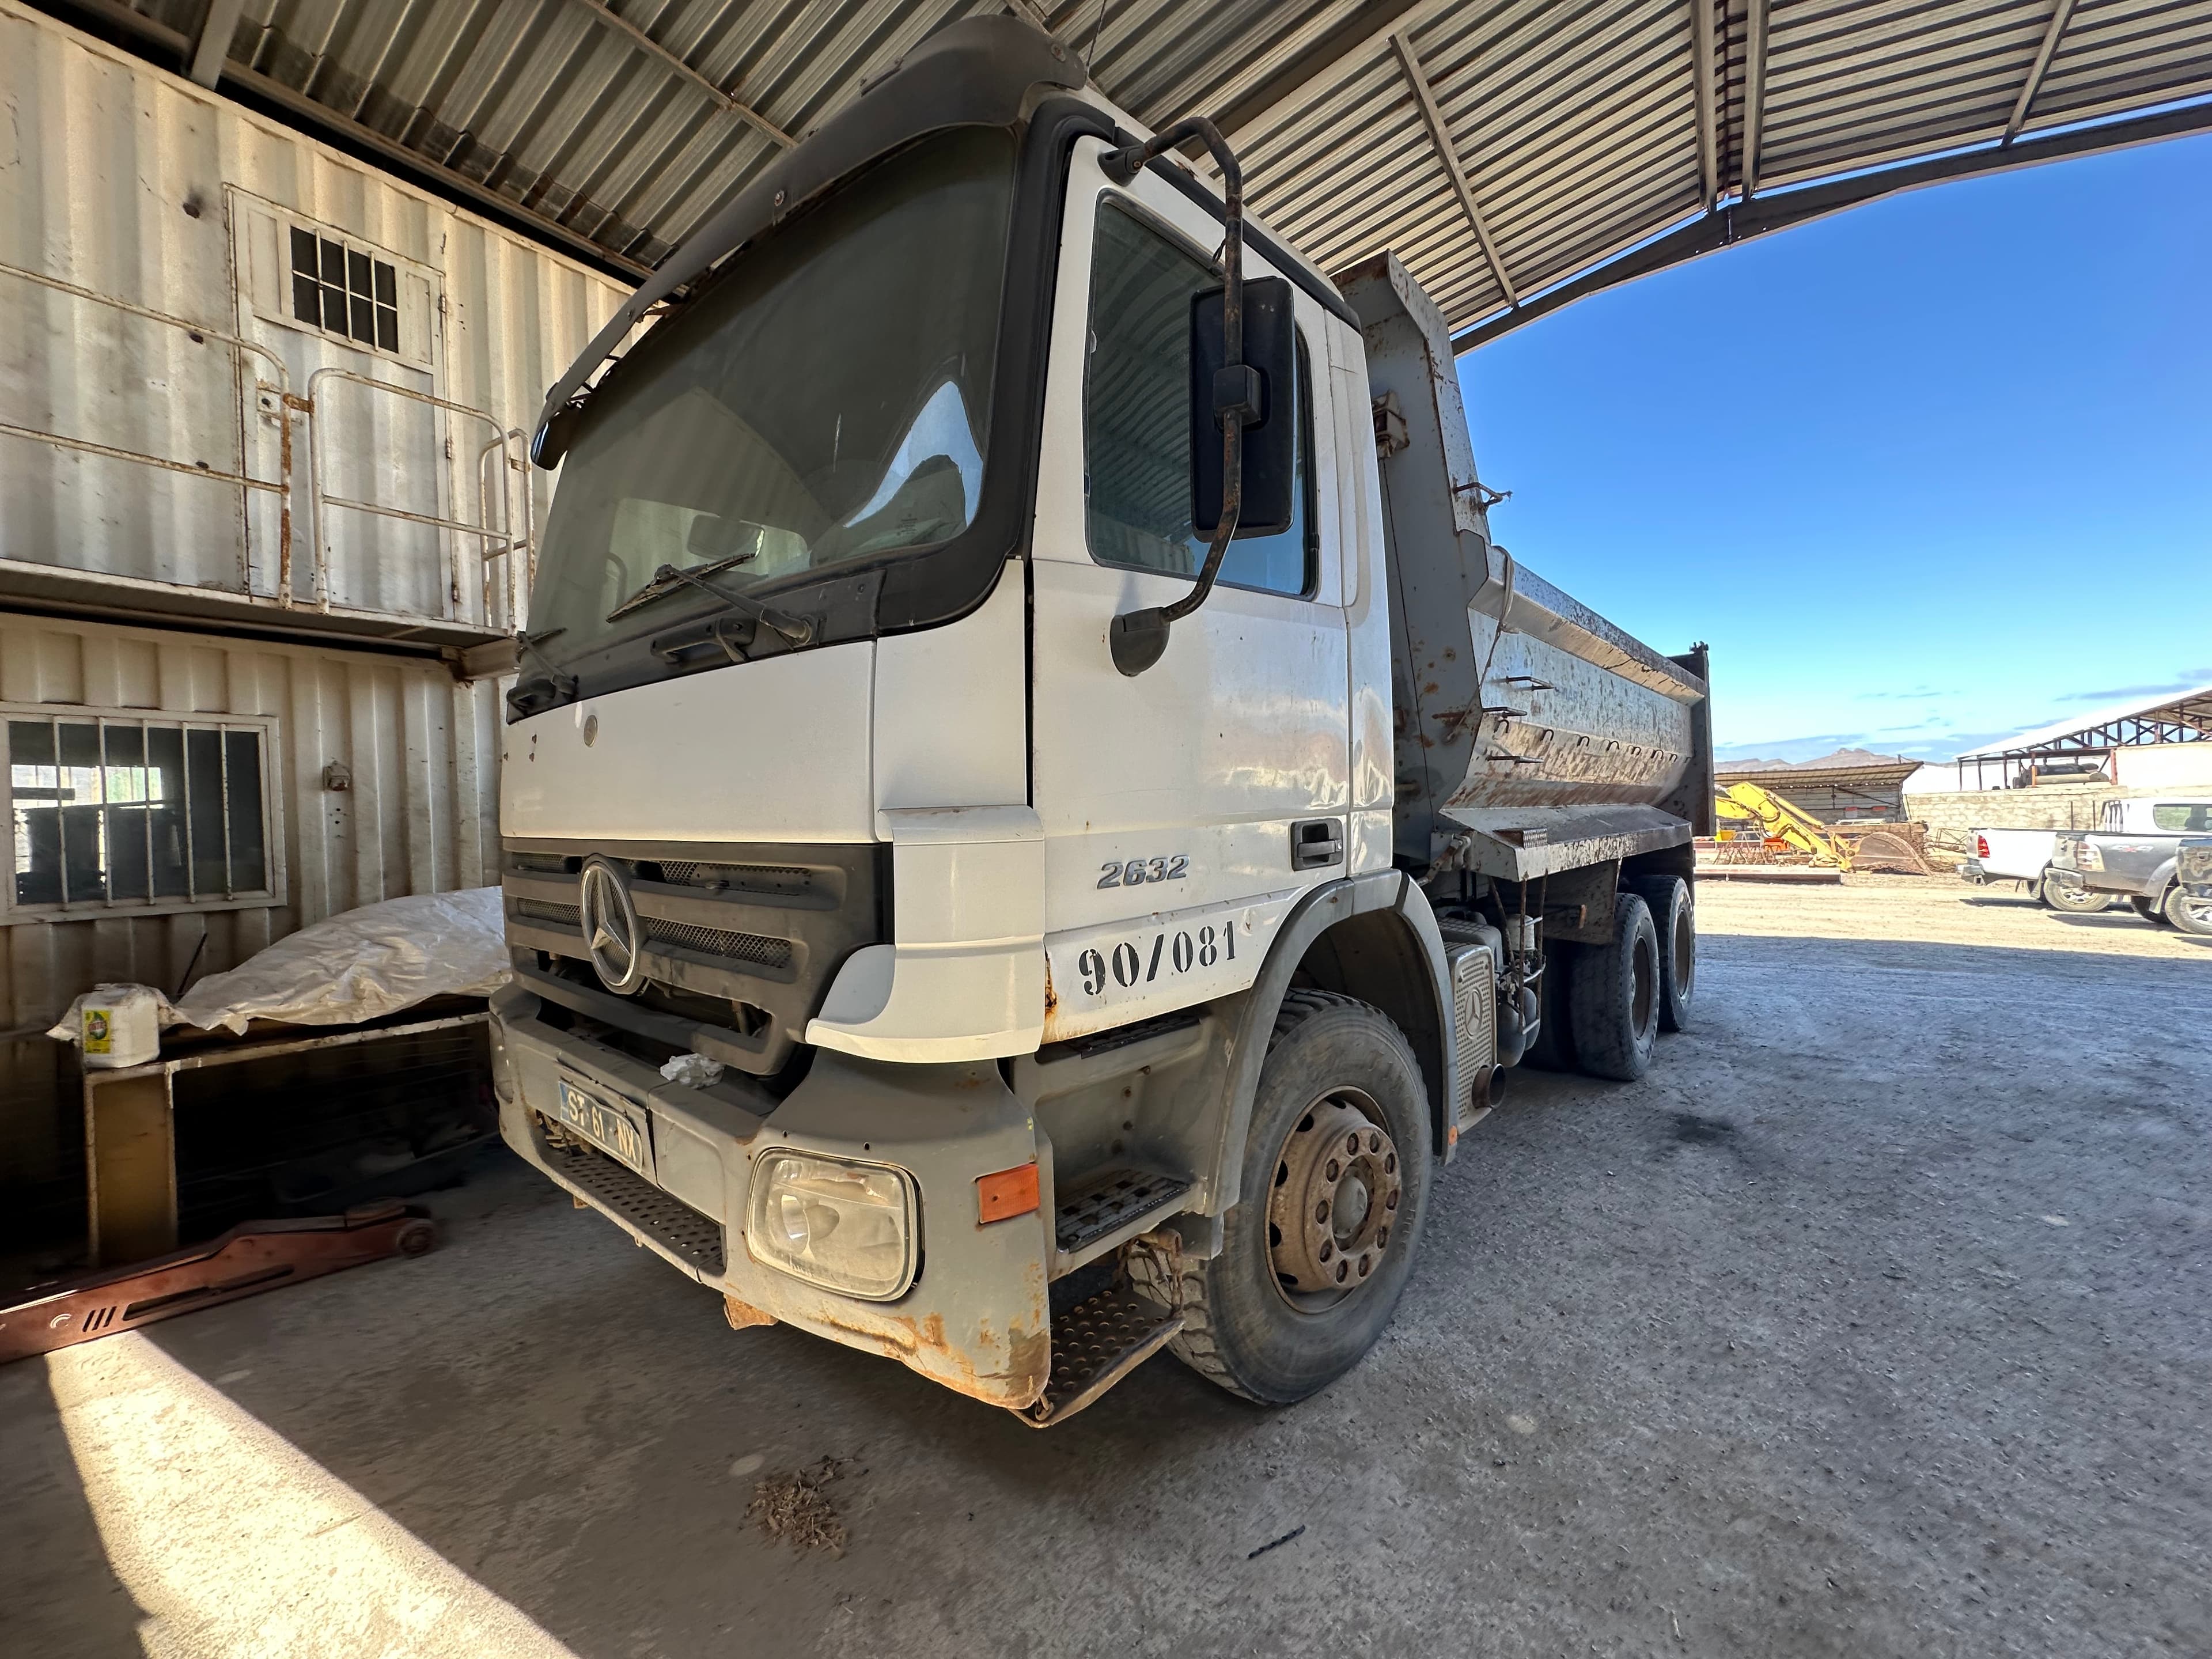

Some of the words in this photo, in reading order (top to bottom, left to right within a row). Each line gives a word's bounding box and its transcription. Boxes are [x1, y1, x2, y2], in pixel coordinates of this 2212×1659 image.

[1096, 854, 1190, 889] 2632
[1078, 920, 1236, 996] 90/081
[568, 1090, 585, 1126] ST
[592, 1106, 605, 1142] 61
[616, 1118, 637, 1162] NX
